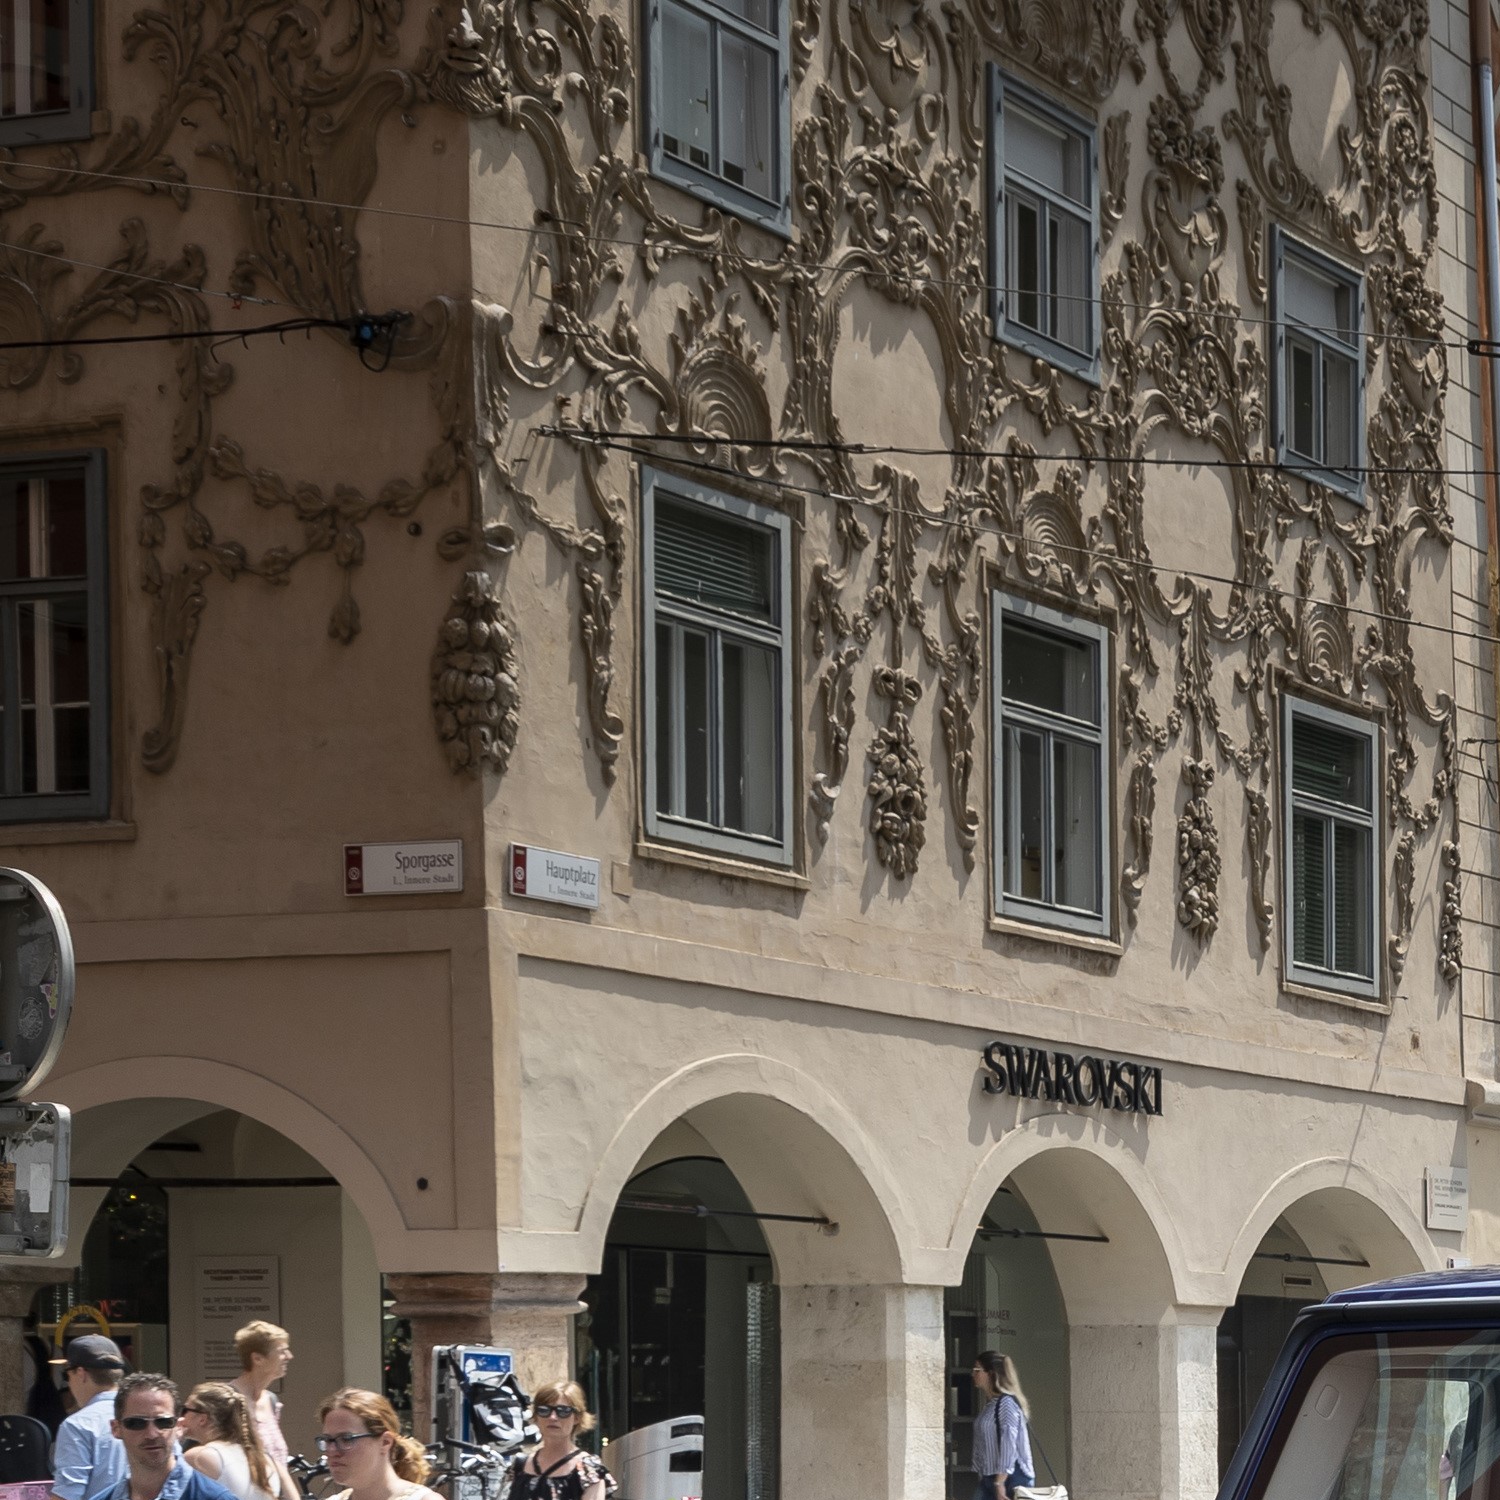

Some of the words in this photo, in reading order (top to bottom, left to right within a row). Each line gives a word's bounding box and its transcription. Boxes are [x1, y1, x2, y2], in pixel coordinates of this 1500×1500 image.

[394, 851, 455, 873] Sporgasse
[545, 859, 596, 886] Hauptplatz
[982, 1041, 1164, 1117] SWAROVSKI
